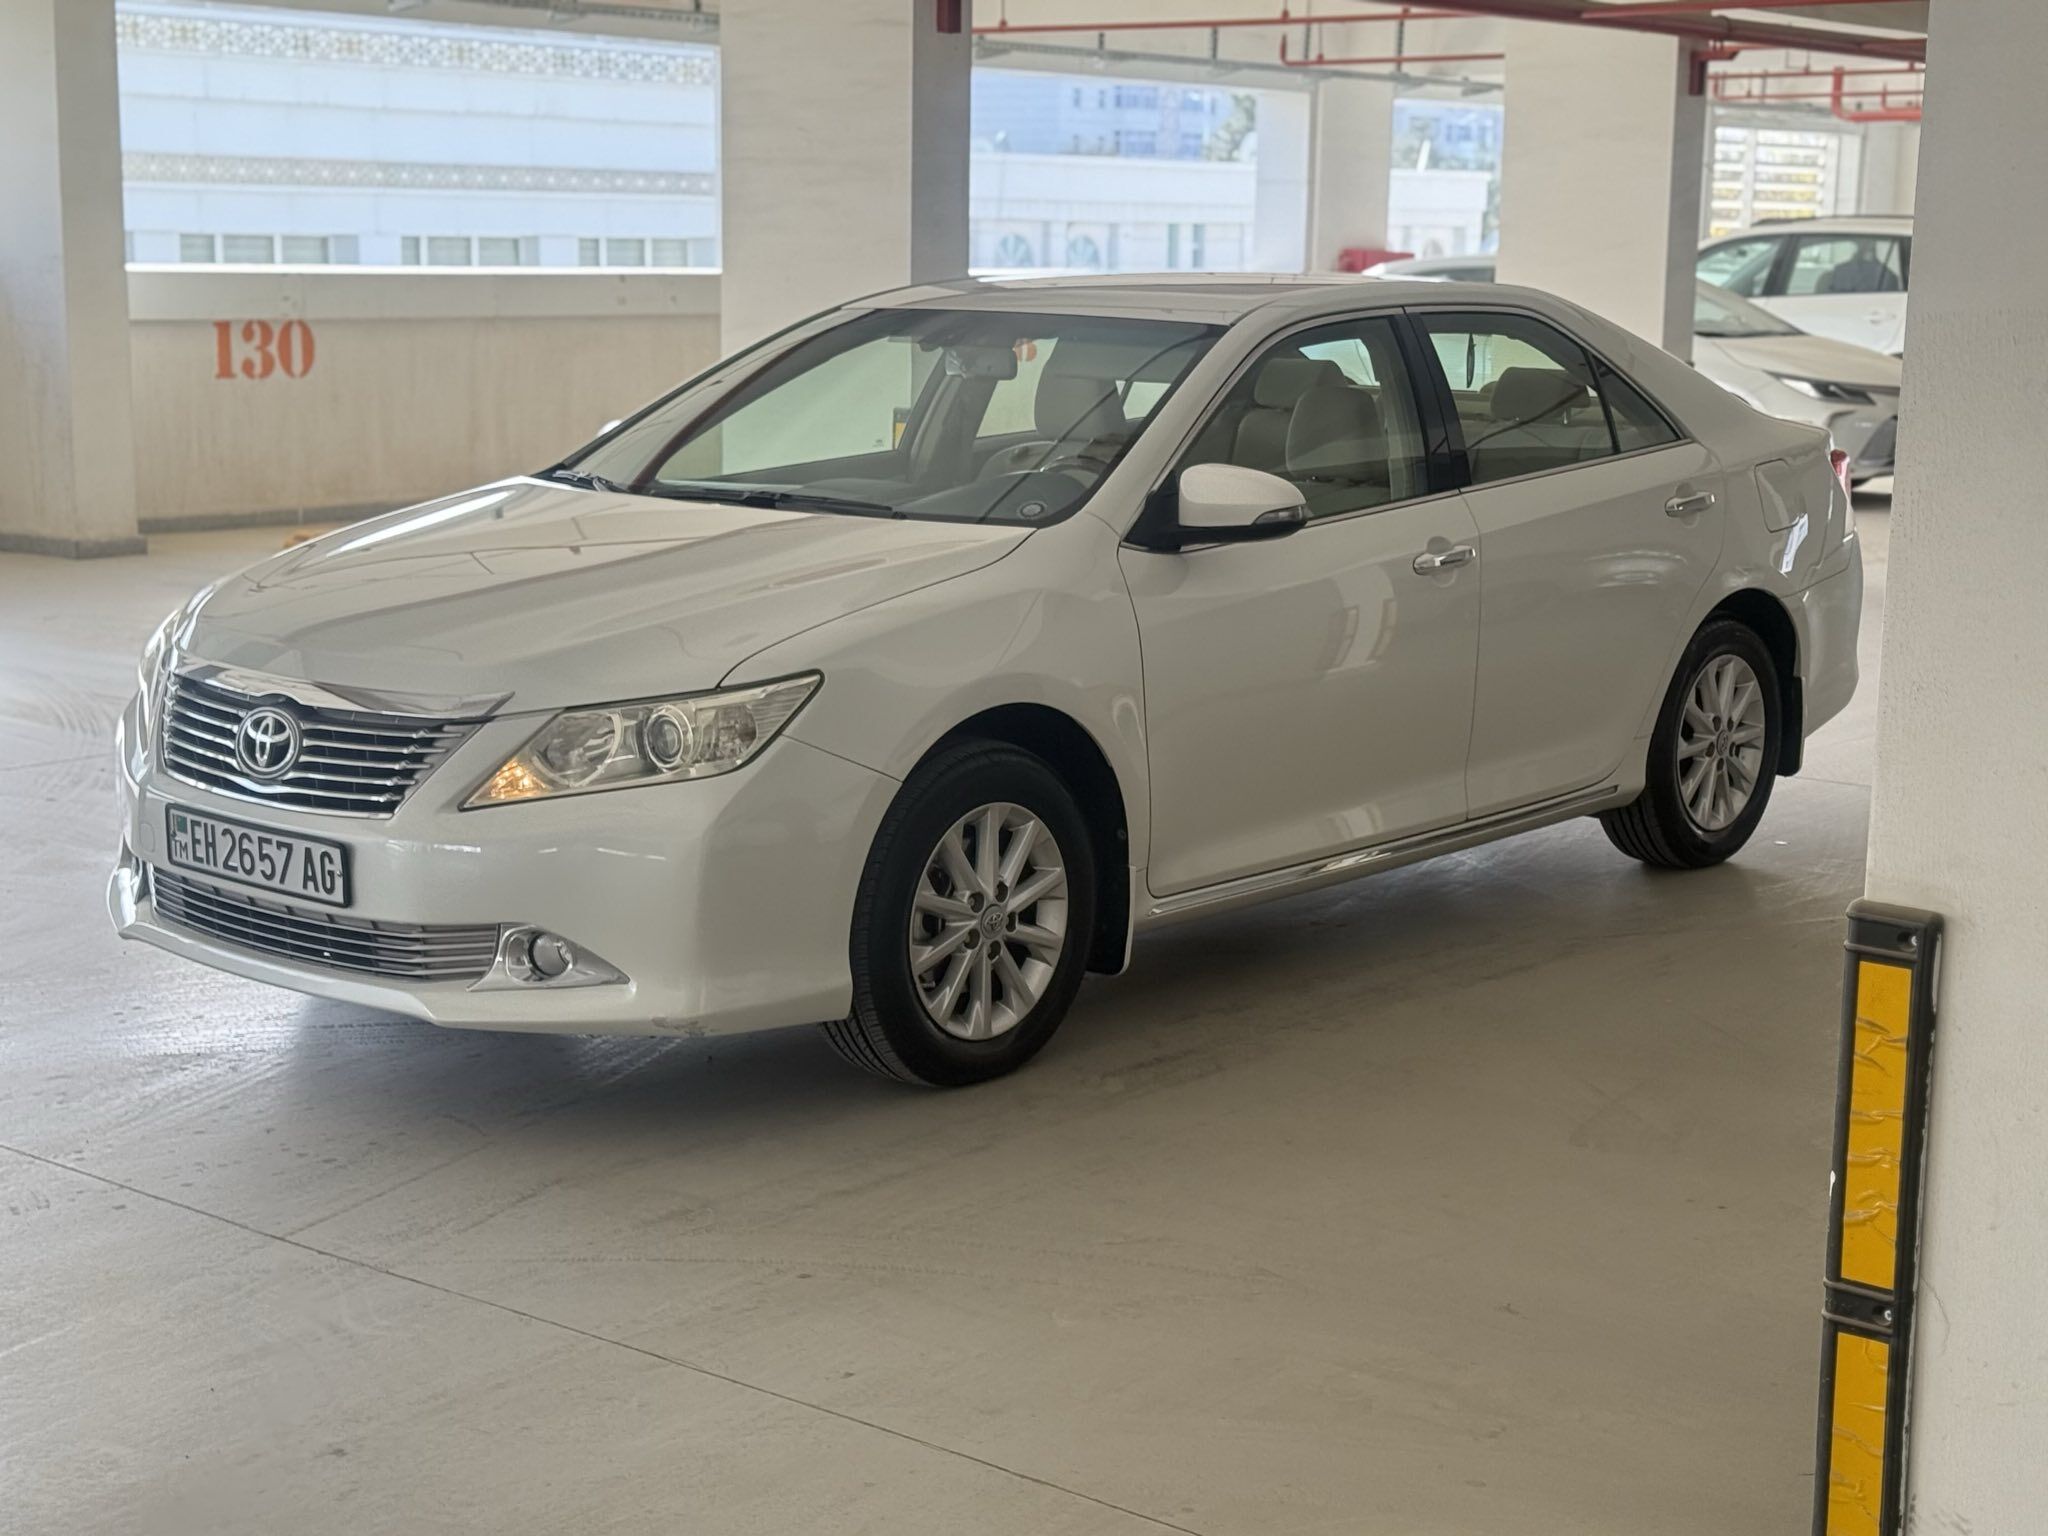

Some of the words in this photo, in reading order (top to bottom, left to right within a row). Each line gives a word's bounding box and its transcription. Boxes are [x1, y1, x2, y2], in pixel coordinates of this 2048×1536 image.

[213, 319, 316, 380] 130
[172, 838, 189, 860] TM
[302, 846, 336, 895] AG
